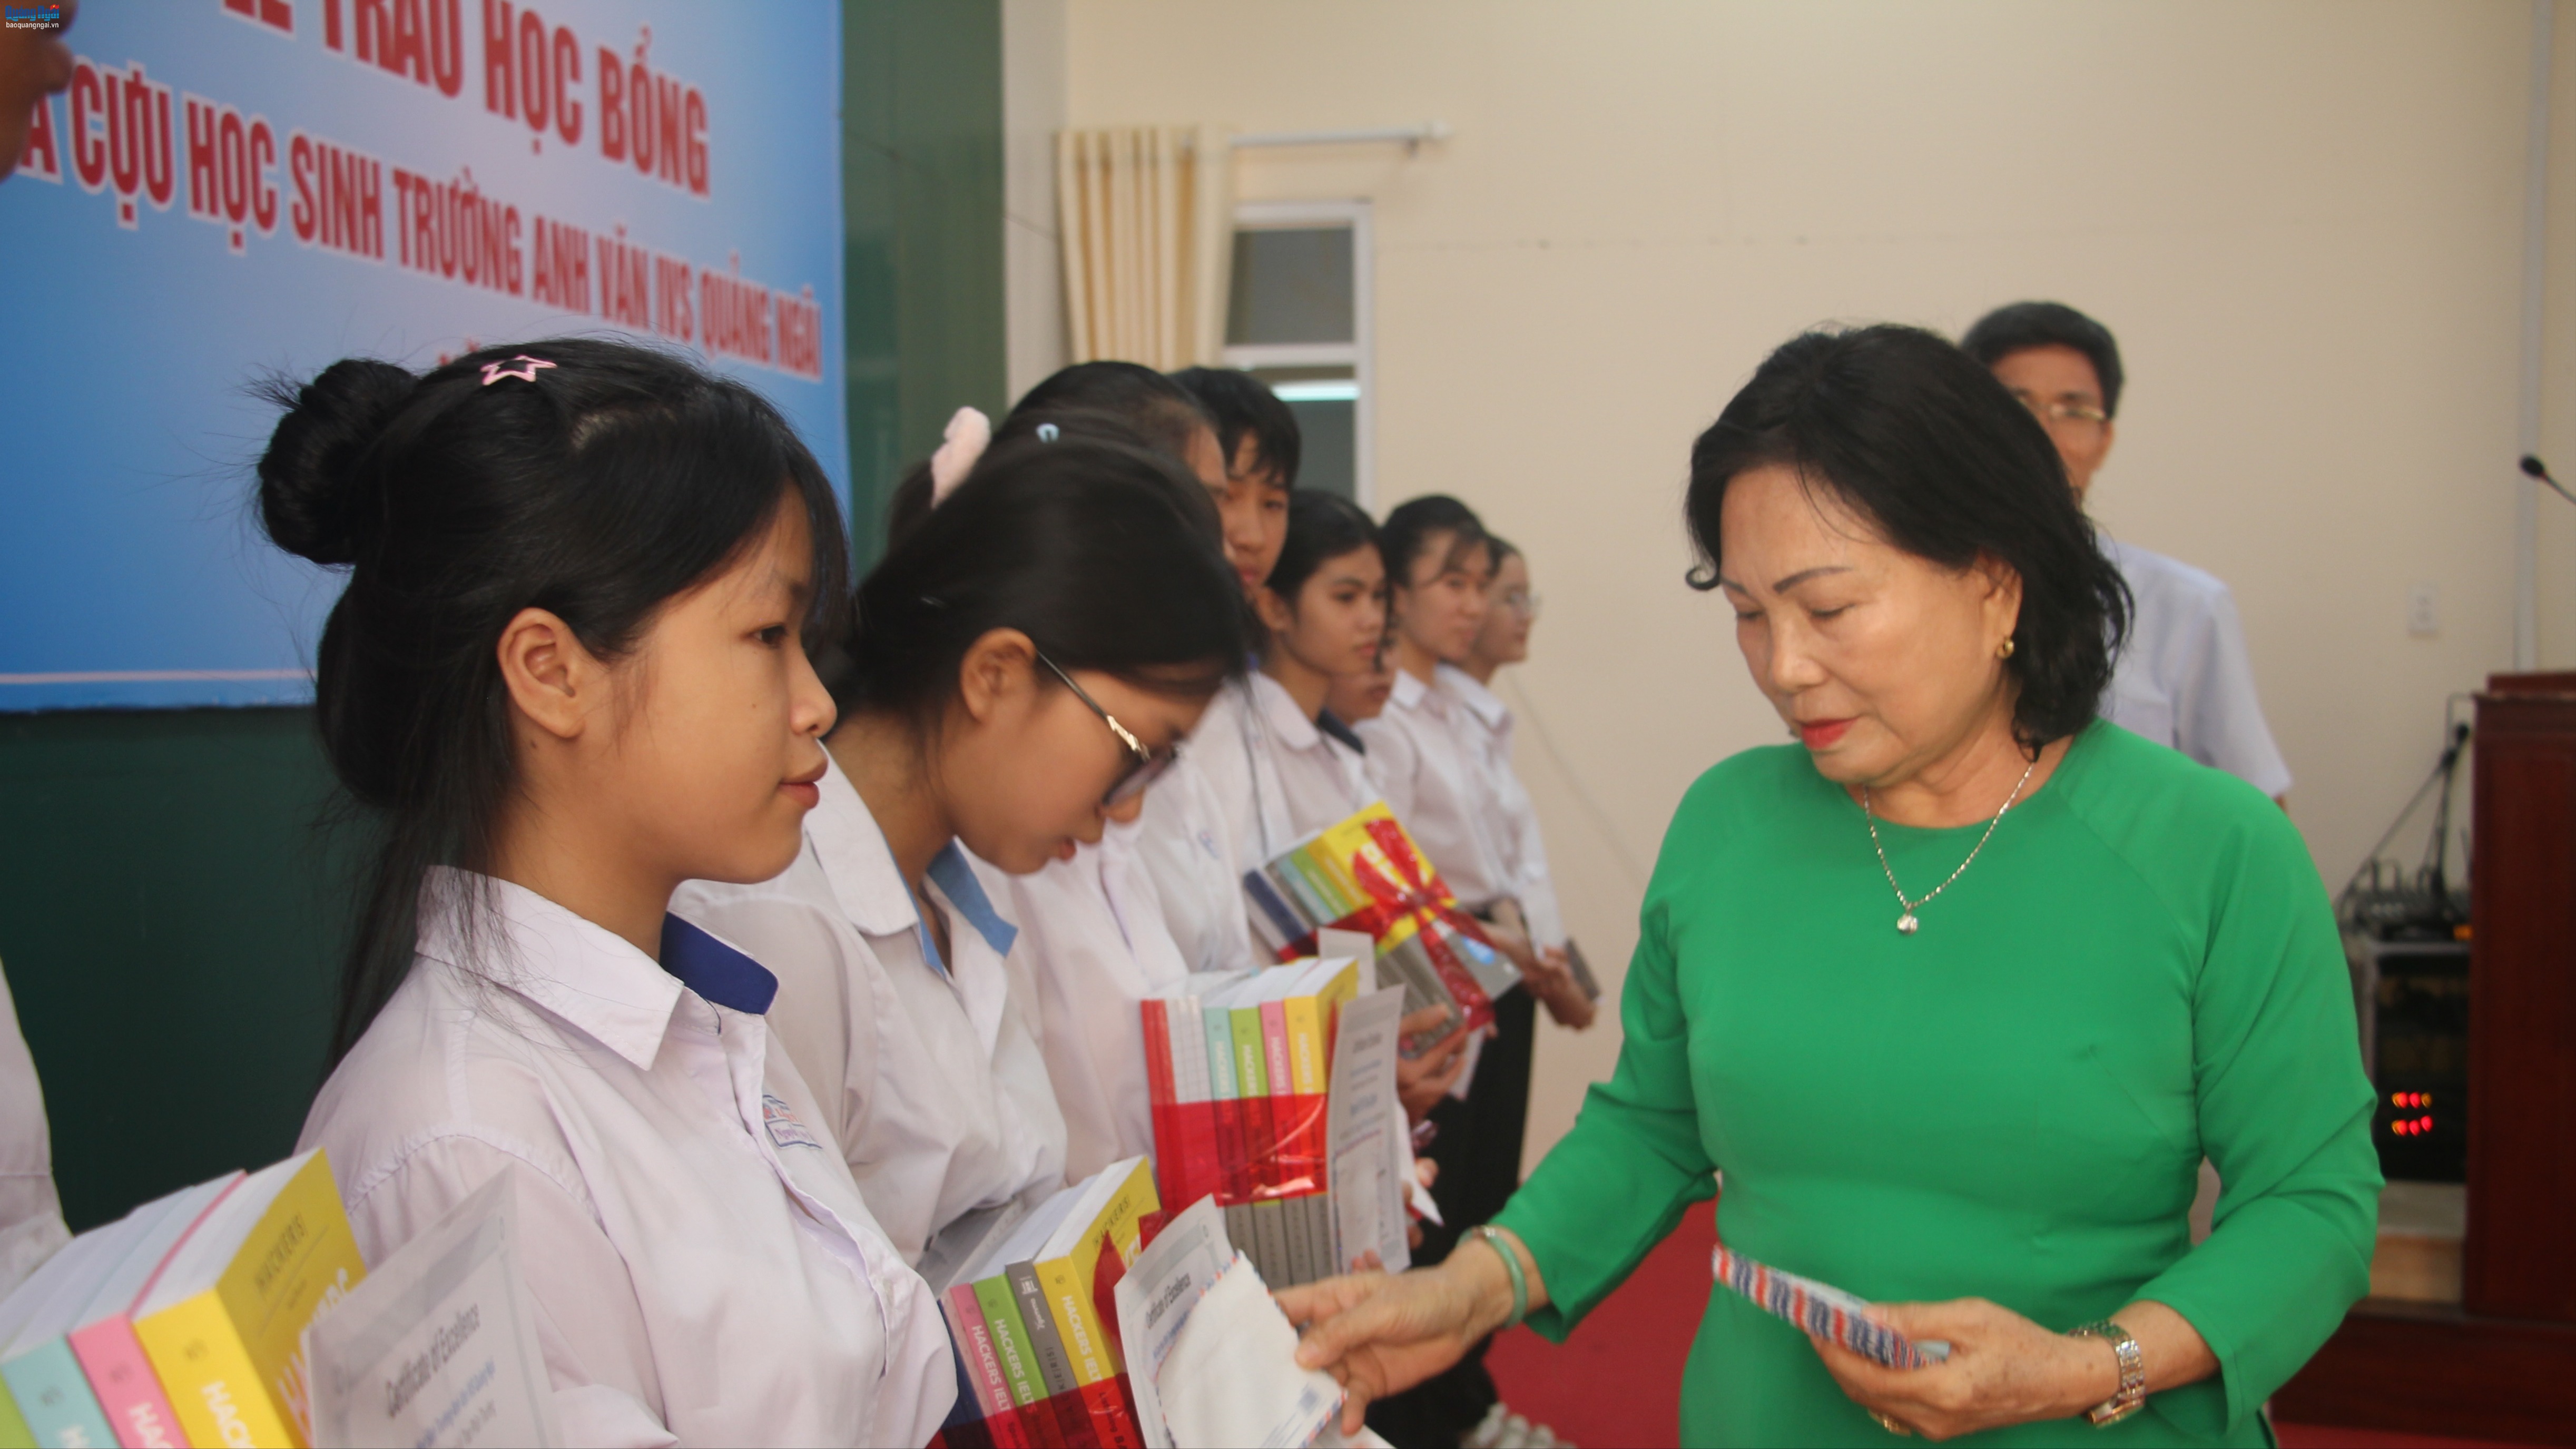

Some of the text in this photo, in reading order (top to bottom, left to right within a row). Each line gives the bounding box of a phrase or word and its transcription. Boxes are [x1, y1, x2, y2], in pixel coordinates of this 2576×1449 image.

[481, 0, 583, 154] HỌC
[597, 26, 710, 199] BỔNG
[71, 63, 173, 222] CỰU
[187, 100, 277, 249] HỌC
[291, 134, 385, 260] SINH
[394, 166, 523, 297] TRƯỜNG
[533, 215, 590, 315] ANH
[596, 221, 649, 331] VĂN
[700, 250, 770, 363] QUẢNG
[776, 284, 822, 379] NGÃI
[972, 1325, 1001, 1385] HACKERS
[994, 1318, 1038, 1414] HACKERS IELTS
[1061, 1295, 1092, 1356] HACKERS
